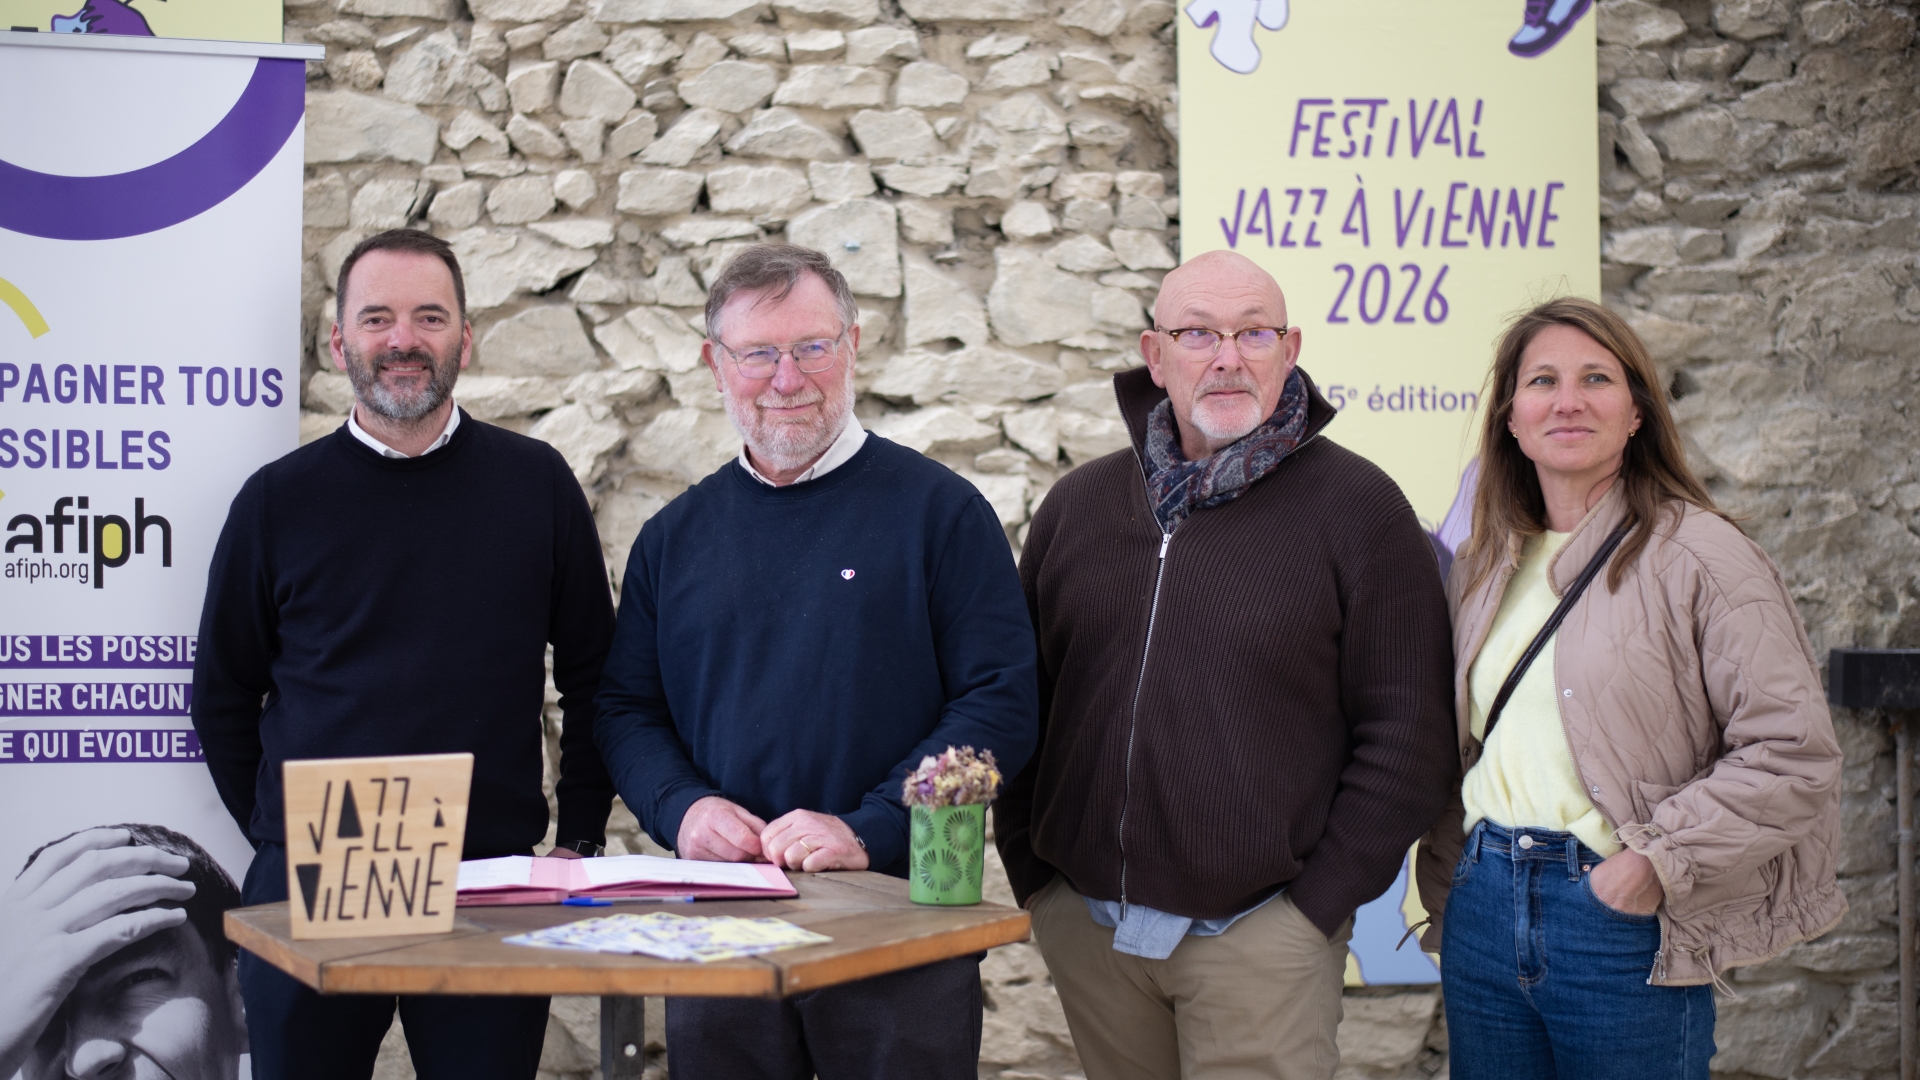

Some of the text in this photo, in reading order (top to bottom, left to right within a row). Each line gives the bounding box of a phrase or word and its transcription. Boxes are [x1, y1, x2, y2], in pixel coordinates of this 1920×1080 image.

[1289, 98, 1486, 158] FESTIVAL
[1220, 174, 1565, 248] JAZZ À VIENNE
[1327, 263, 1450, 324] 2026
[0, 363, 284, 408] PAGNER TOUS
[1316, 384, 1478, 412] 5e édition
[0, 428, 172, 471] SSIBLES
[5, 496, 172, 589] afiph
[5, 558, 89, 584] afiph.org
[41, 635, 93, 662] LES
[0, 684, 62, 711] NER
[23, 732, 68, 762] QUI
[308, 777, 446, 855] JAZZ À
[295, 841, 449, 922] VIENNE
